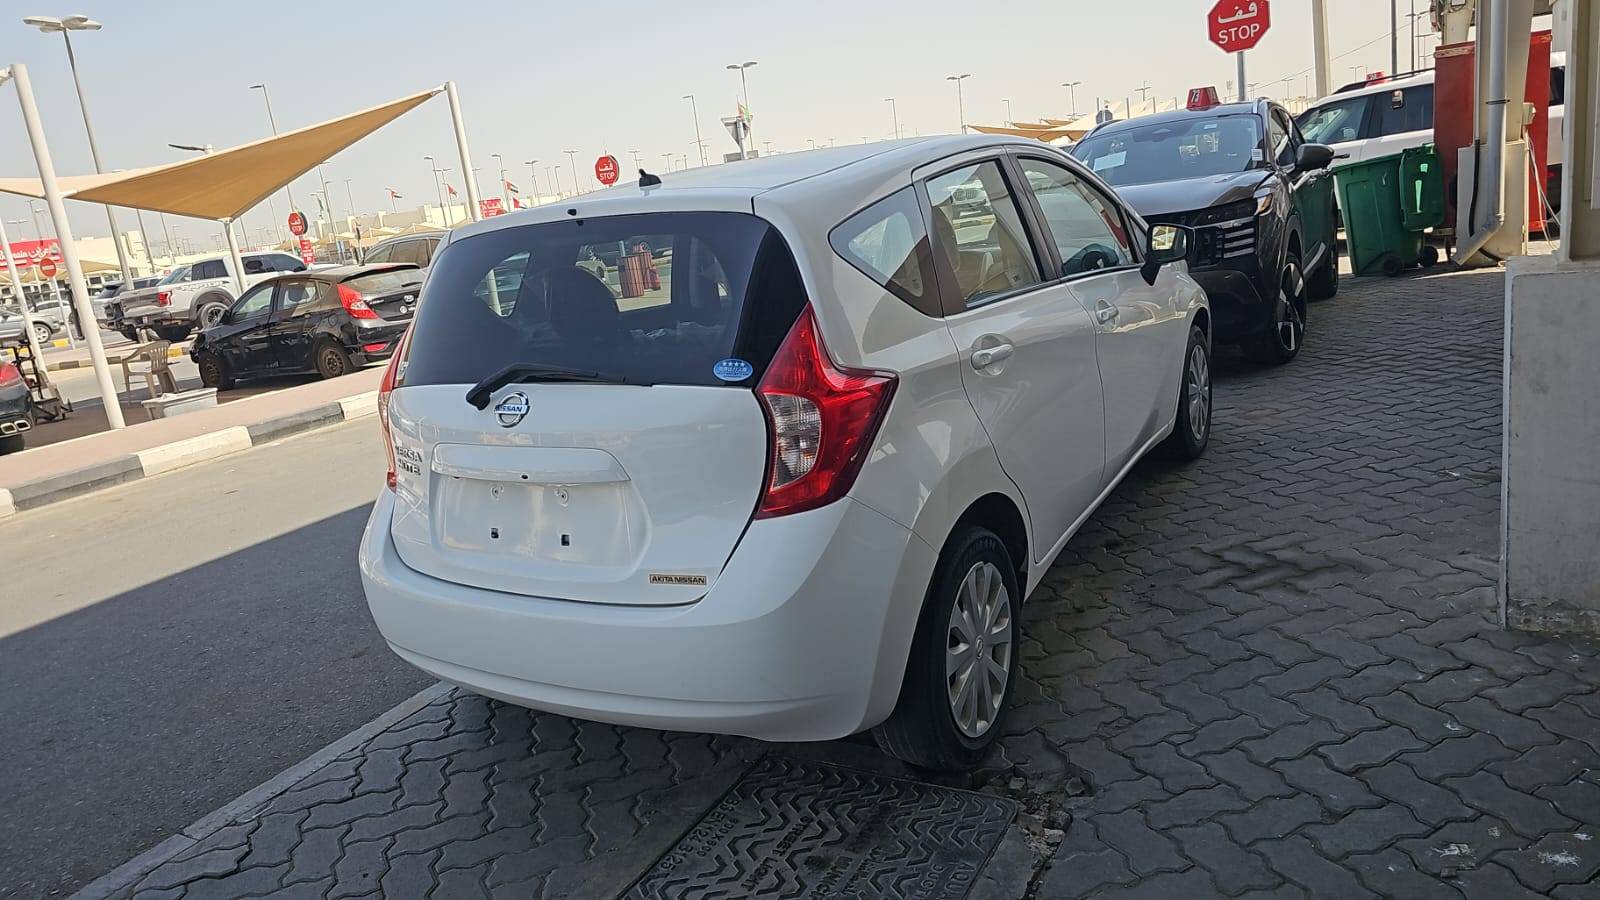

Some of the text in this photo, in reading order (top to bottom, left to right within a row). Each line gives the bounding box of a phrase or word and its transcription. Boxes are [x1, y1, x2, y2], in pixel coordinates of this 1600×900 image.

[1218, 0, 1258, 23] قف
[1218, 23, 1260, 44] STOP
[599, 171, 615, 181] STOP
[495, 404, 523, 413] NISSAN
[651, 575, 705, 584] AKITA NISSAN
[740, 815, 813, 892] STREET LIGHT
